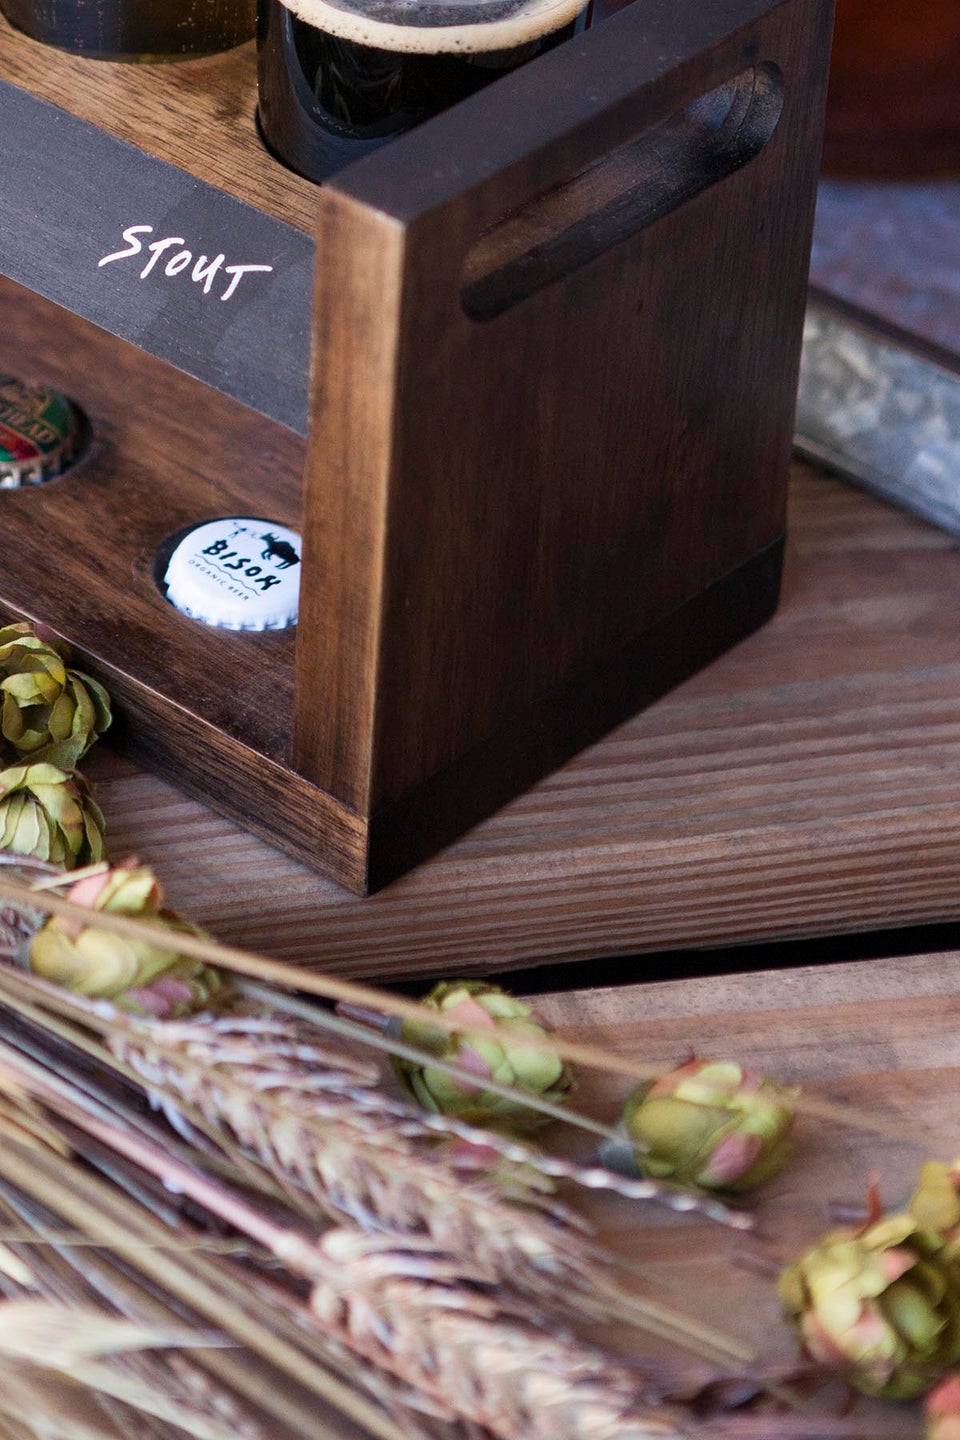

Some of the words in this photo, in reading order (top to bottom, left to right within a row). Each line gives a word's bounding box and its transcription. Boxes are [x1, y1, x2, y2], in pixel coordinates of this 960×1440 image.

[98, 225, 273, 301] STOUT
[188, 559, 227, 585] ORGANIC
[202, 539, 281, 591] BISON
